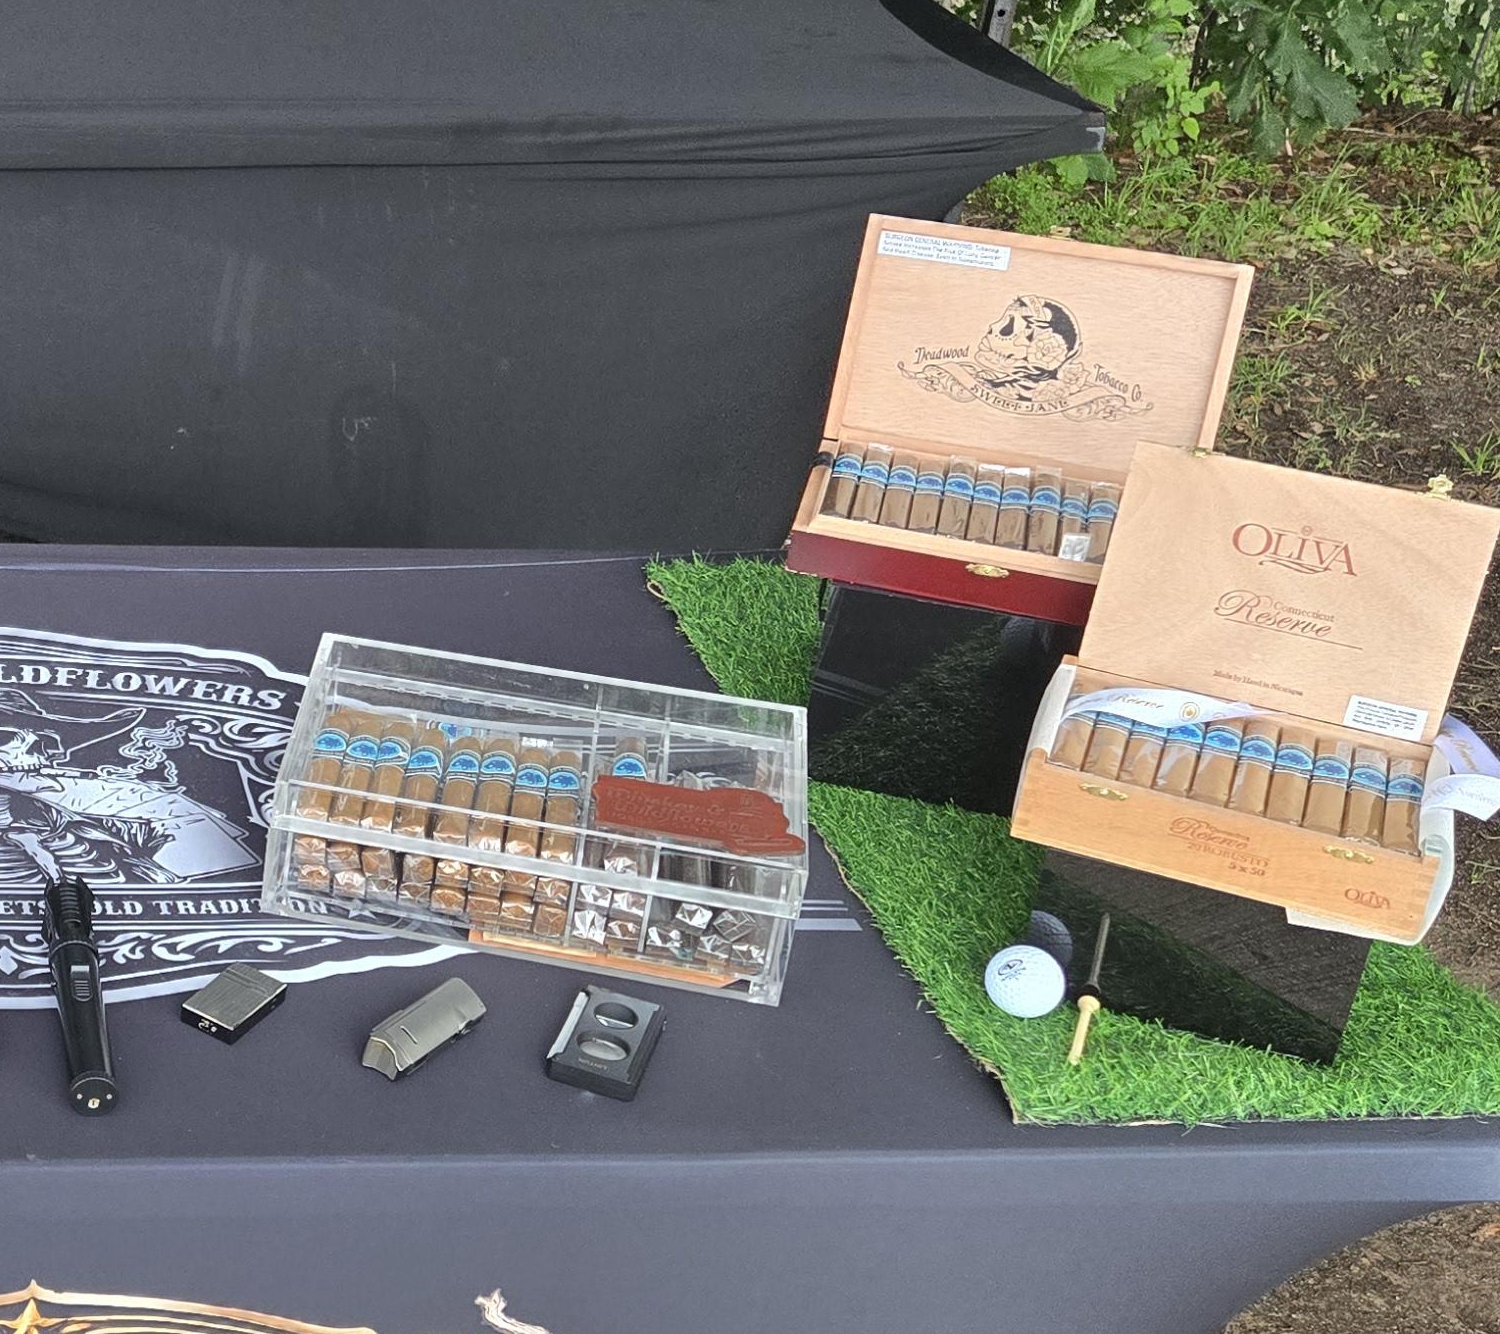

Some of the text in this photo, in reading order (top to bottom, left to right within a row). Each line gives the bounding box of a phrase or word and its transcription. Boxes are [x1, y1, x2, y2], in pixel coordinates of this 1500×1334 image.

[914, 345, 969, 365] Deadwood
[1093, 363, 1128, 394] Tobacco
[1232, 523, 1358, 576] OLIVA
[1213, 590, 1332, 637] Reserve
[1274, 601, 1335, 622] Connecticut
[91, 899, 143, 916] OLD
[155, 897, 328, 915] TRADITON
